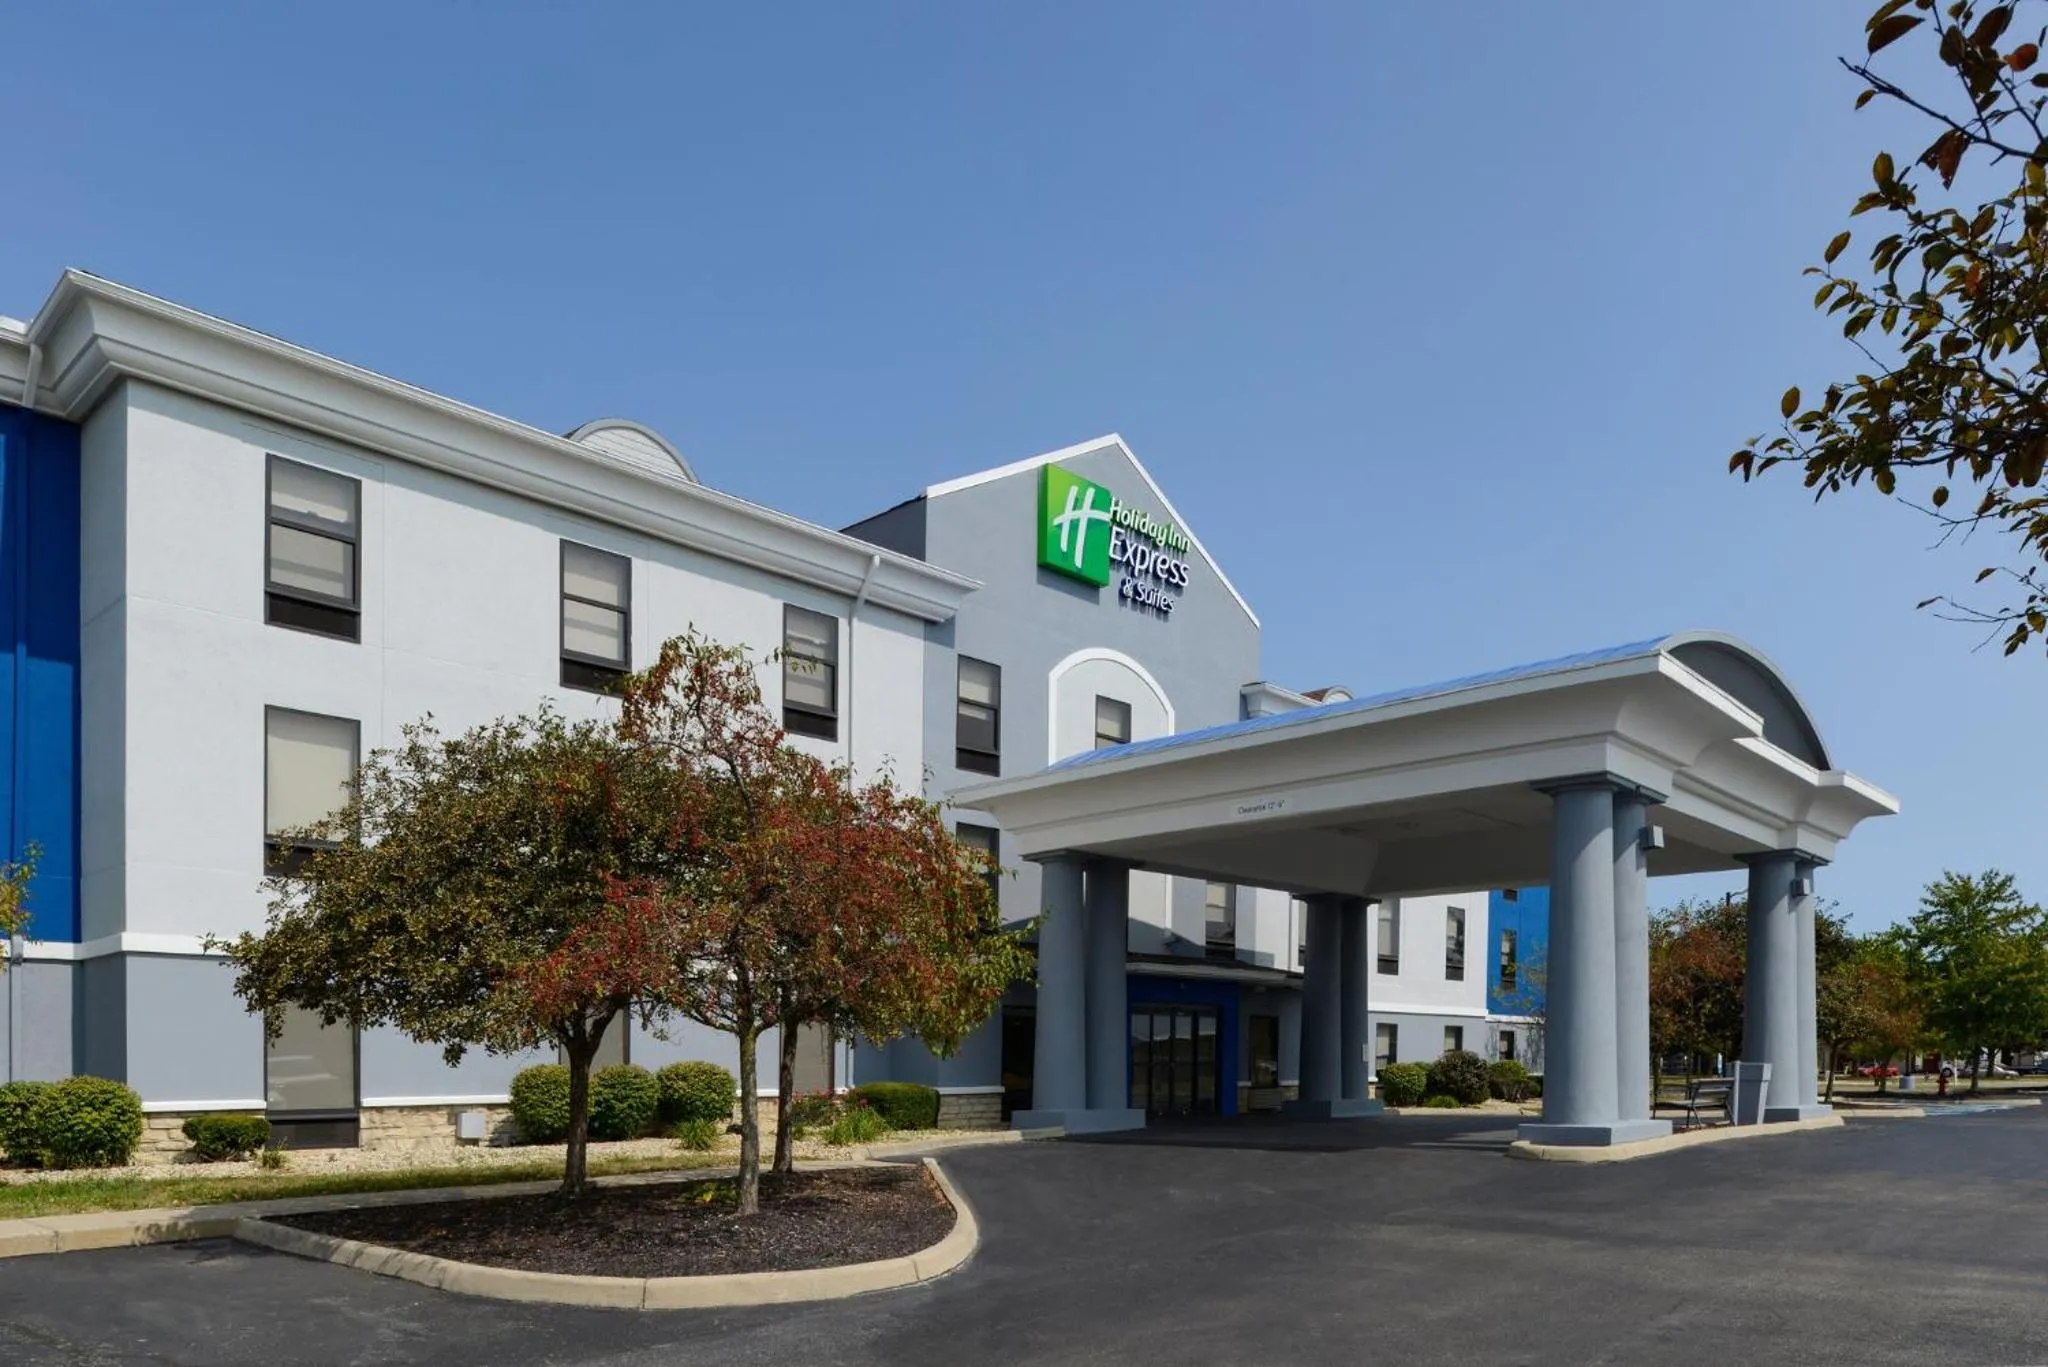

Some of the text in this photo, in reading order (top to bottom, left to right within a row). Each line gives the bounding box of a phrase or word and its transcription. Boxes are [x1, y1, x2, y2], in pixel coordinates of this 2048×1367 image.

[1110, 497, 1190, 552] Holiday Inn
[1109, 526, 1190, 587] Express
[1123, 578, 1175, 612] & Suites
